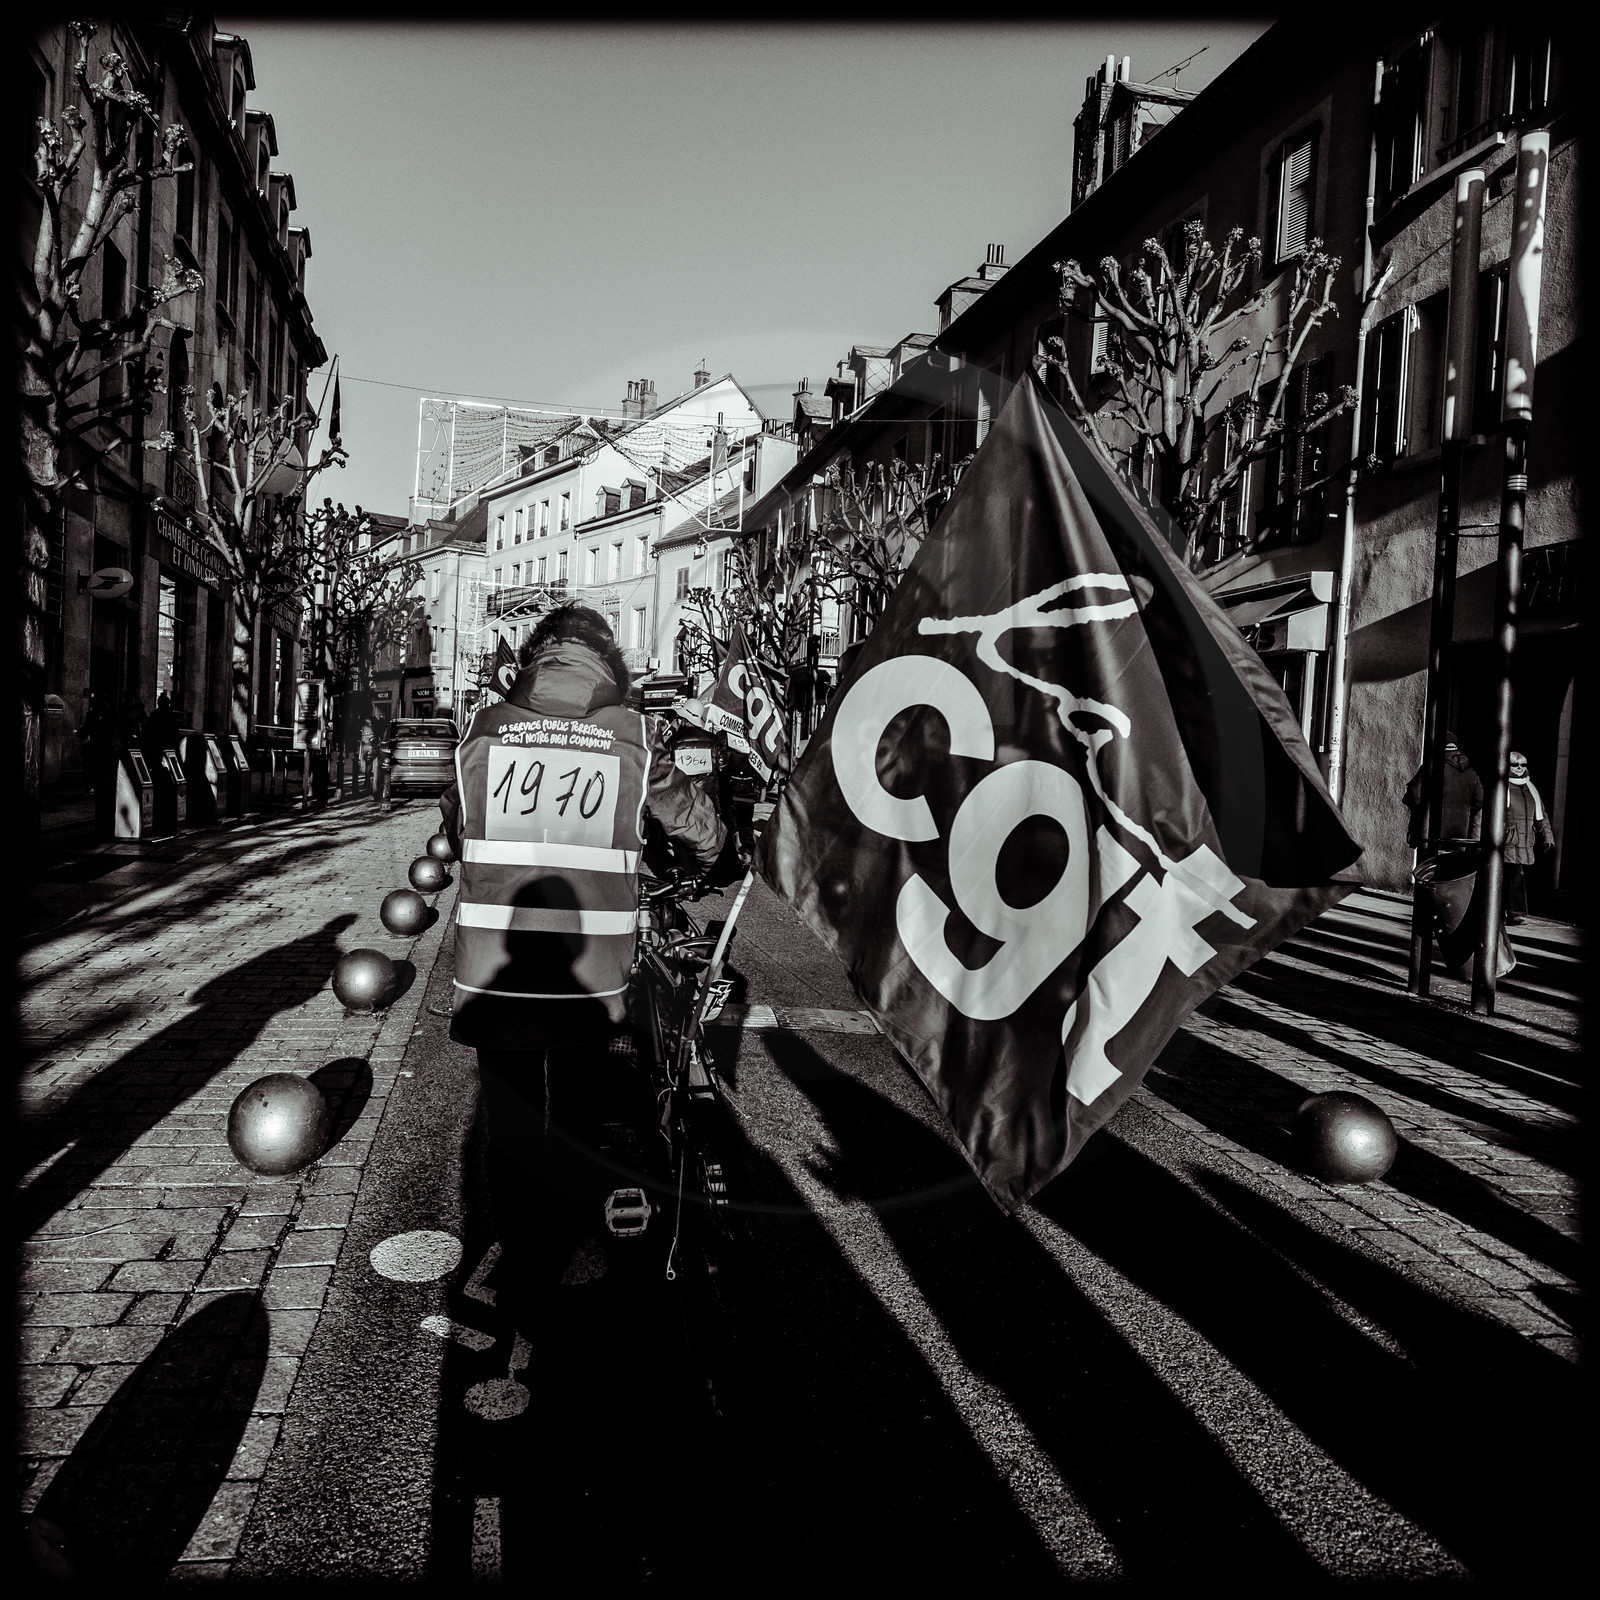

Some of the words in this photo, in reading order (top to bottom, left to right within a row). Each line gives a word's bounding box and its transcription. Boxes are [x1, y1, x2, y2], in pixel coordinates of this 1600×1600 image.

[157, 515, 191, 552] CHAMBRE
[191, 540, 200, 559] DE
[173, 547, 182, 566] ET
[498, 723, 508, 734] LE
[508, 720, 541, 733] SERVICE
[542, 719, 569, 732] PUBLIC
[501, 731, 527, 745] C'EST
[526, 731, 550, 745] NOTRE
[549, 733, 568, 746] BIEN
[678, 754, 707, 767] 1964
[493, 760, 605, 819] 1970
